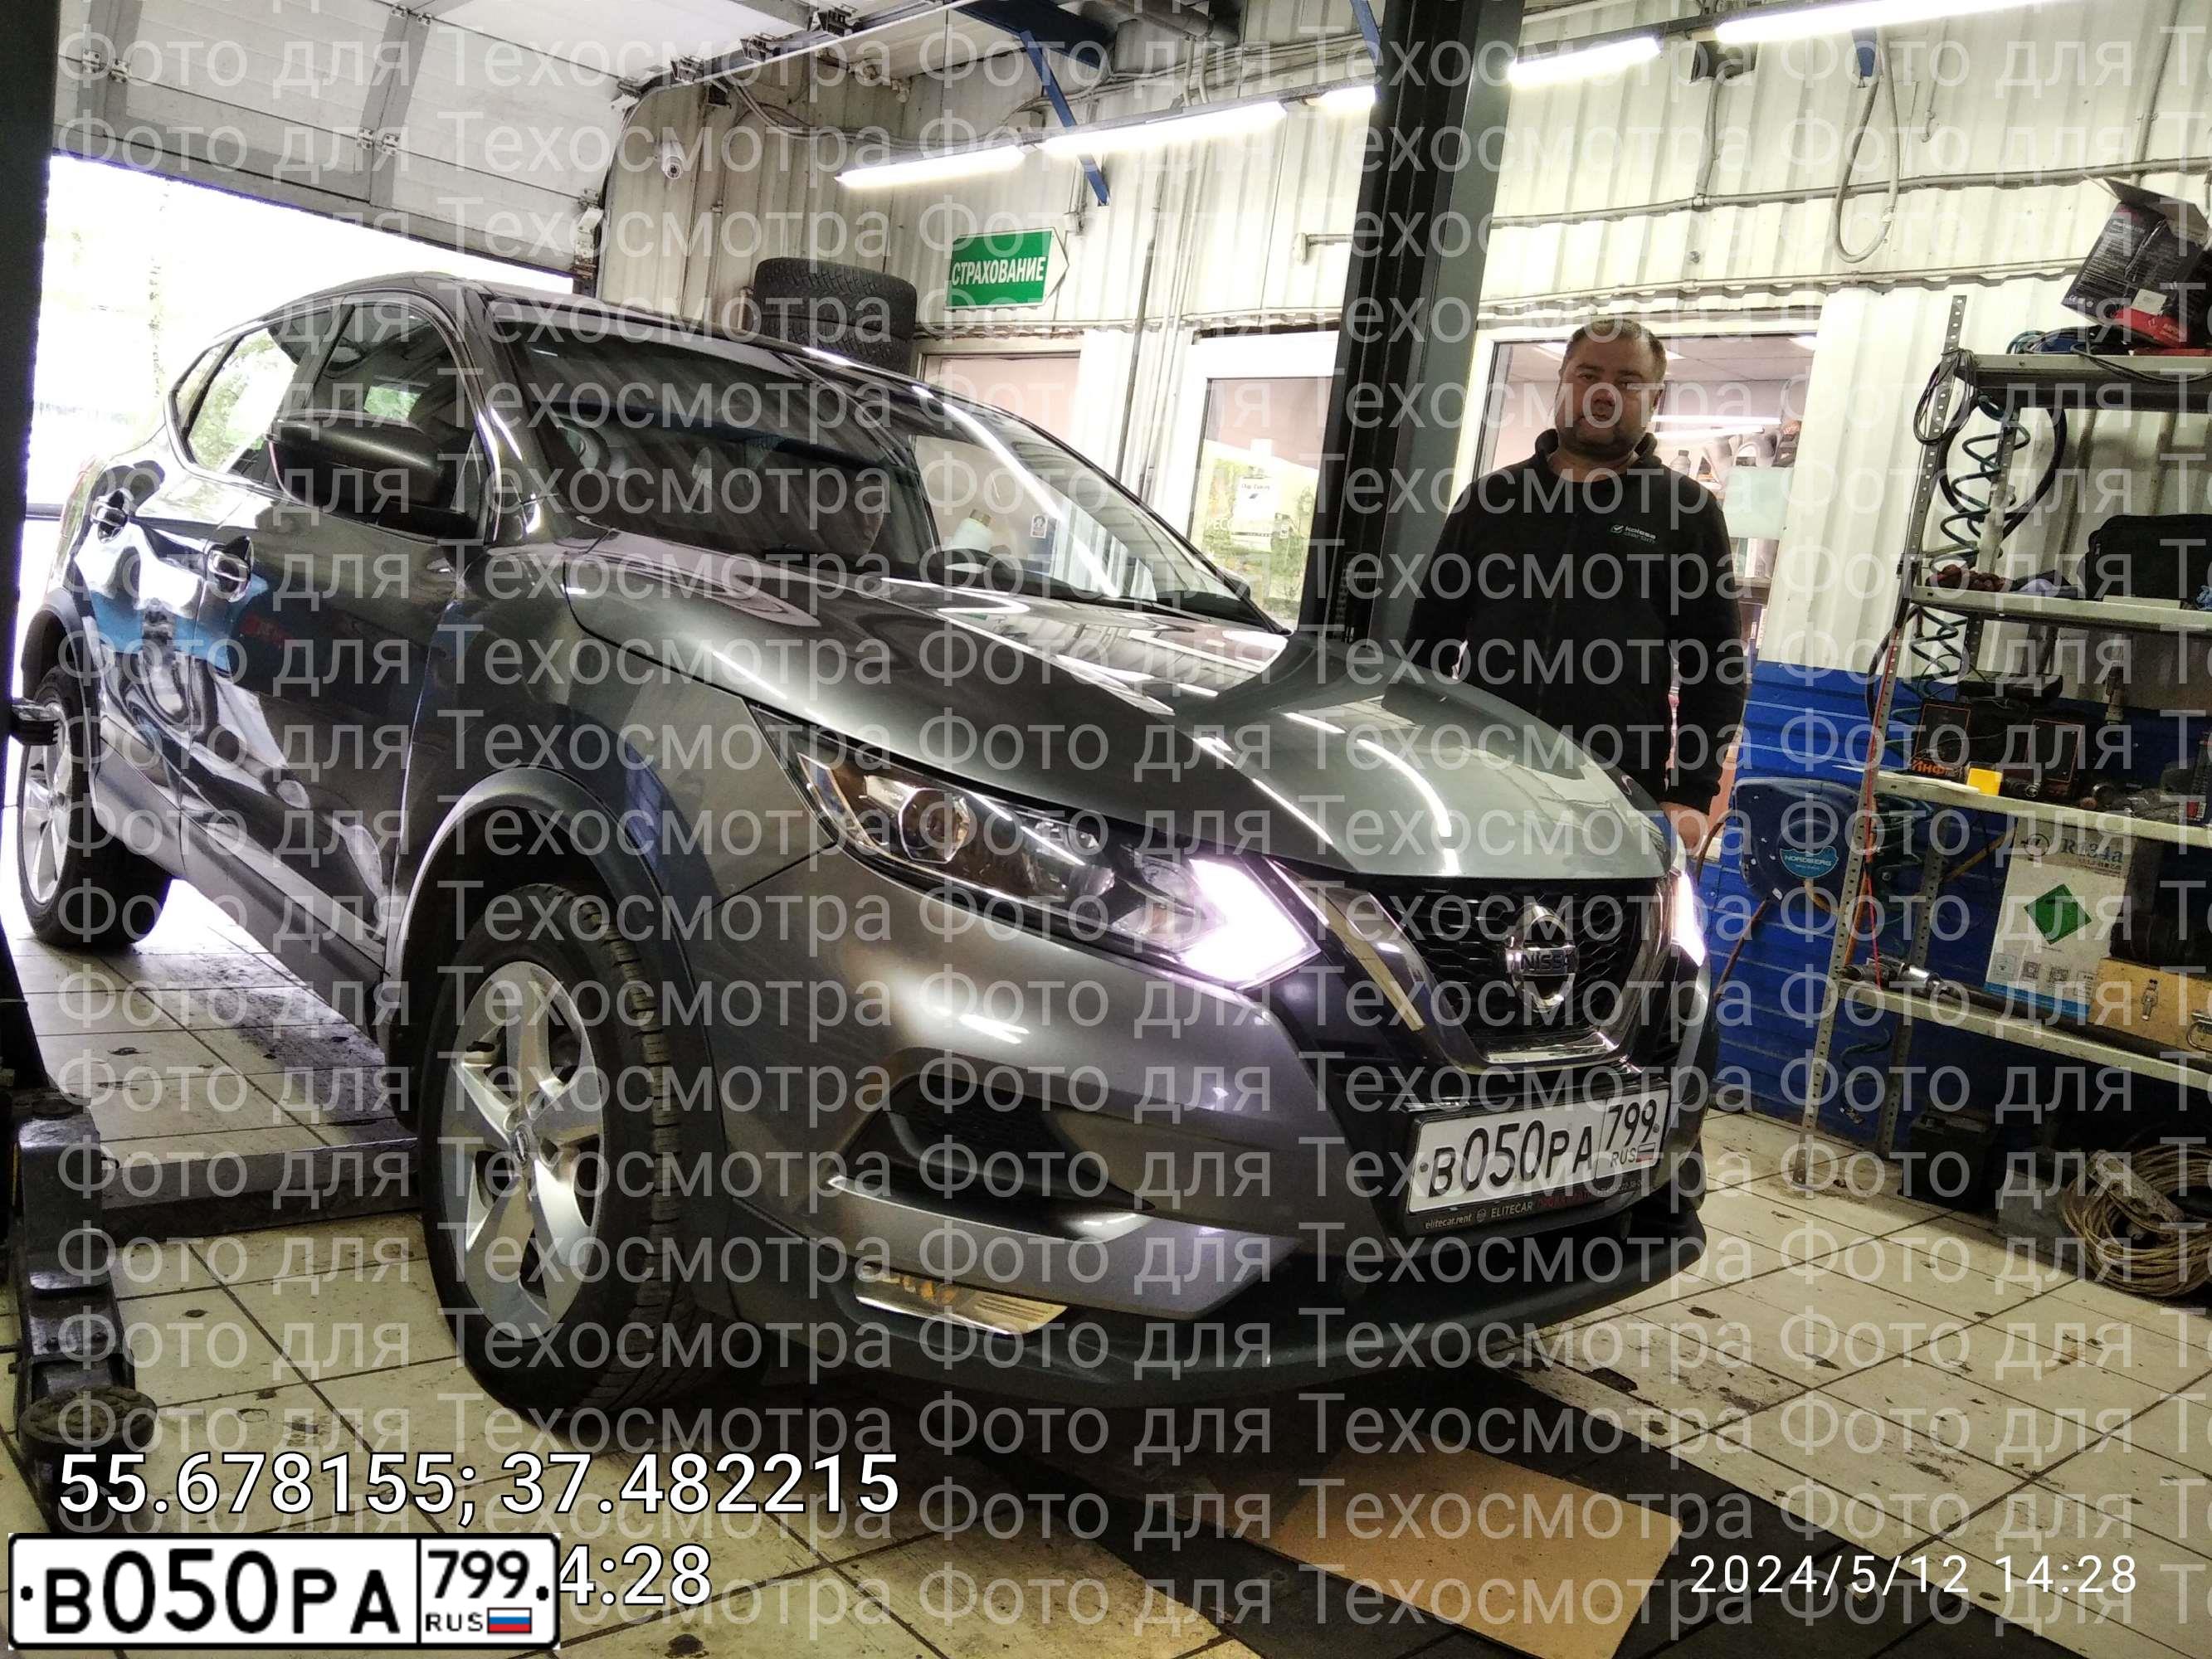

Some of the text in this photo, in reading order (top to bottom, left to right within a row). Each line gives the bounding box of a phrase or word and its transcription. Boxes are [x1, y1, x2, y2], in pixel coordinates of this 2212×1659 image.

[951, 256, 1047, 286] СТРАХОВАНИЕ
[1520, 952, 1573, 971] NISS
[1605, 1098, 1658, 1151] 799
[1610, 1147, 1637, 1168] RUS
[1490, 1202, 1534, 1219] ELITECAR
